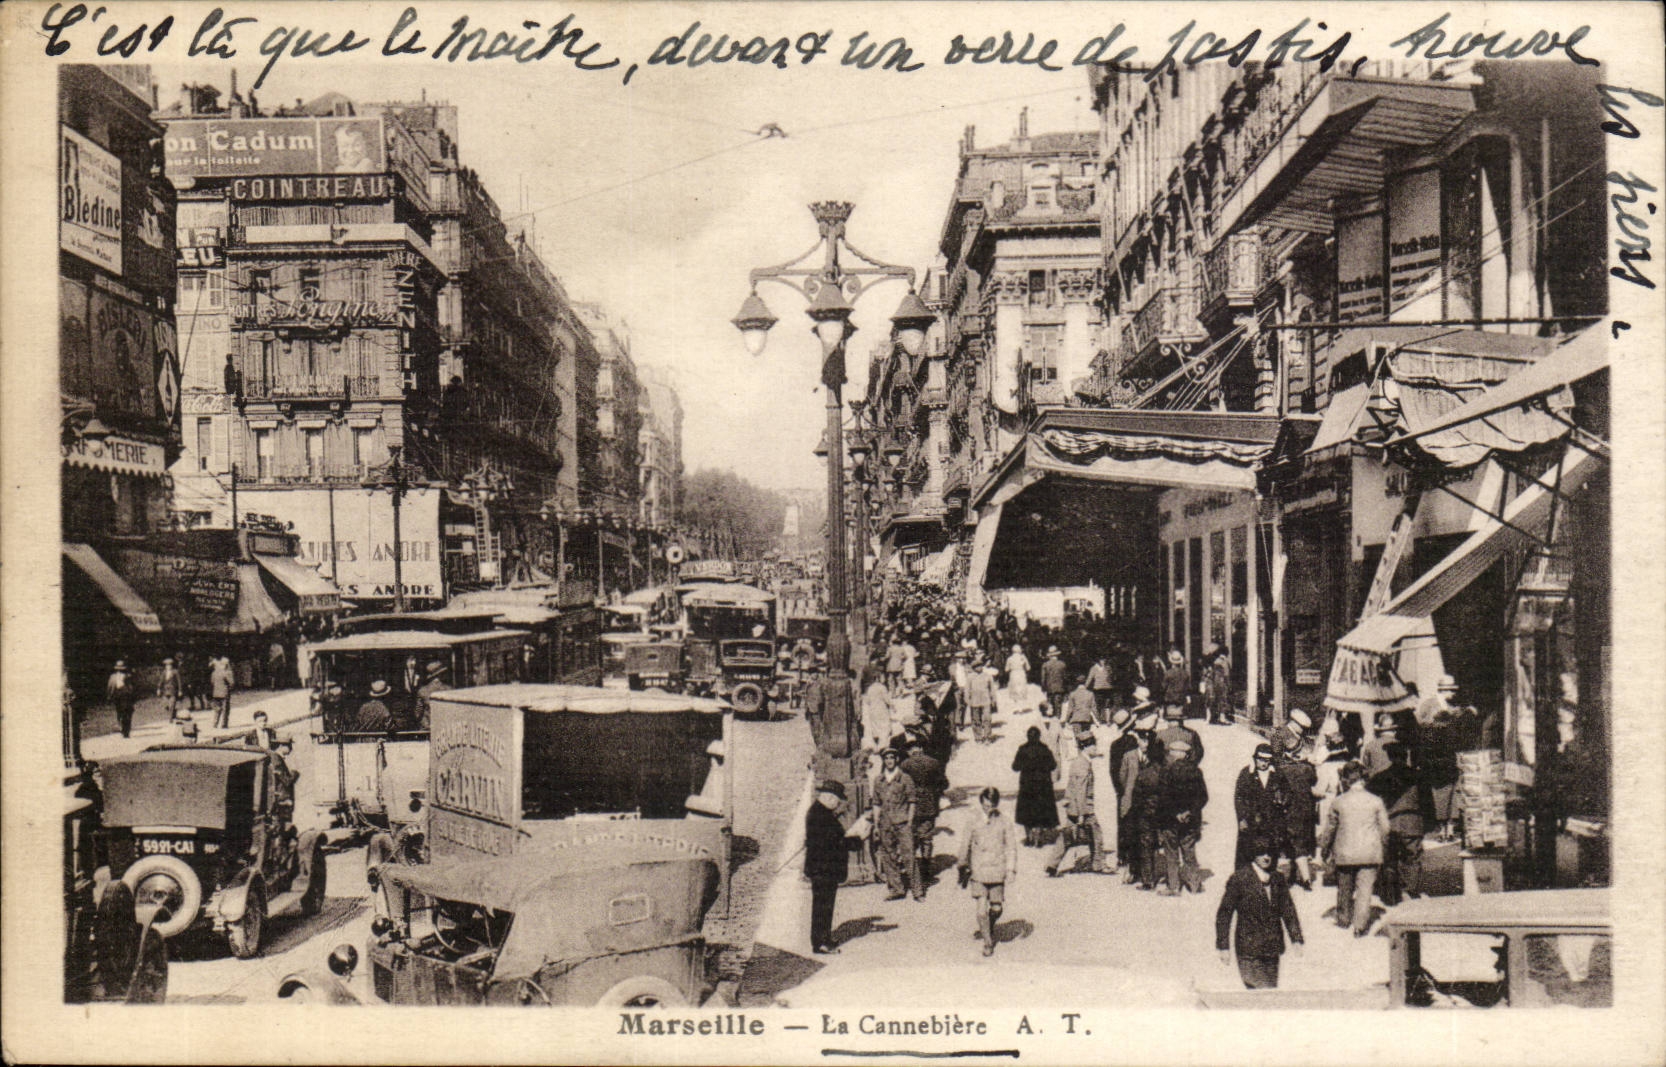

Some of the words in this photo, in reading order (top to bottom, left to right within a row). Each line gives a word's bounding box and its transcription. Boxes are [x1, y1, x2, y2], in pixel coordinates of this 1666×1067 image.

[254, 25, 370, 89] que
[381, 7, 427, 56] le
[647, 20, 833, 69] devant
[840, 31, 925, 72] un
[944, 30, 1063, 71] verre
[1072, 22, 1150, 74] de
[1389, 12, 1600, 67] trouve
[211, 129, 315, 151] Cadum
[233, 178, 383, 200] COINTREAU
[63, 184, 121, 231] Blédine
[398, 270, 417, 390] ZENITH
[372, 584, 434, 595] ANDRE
